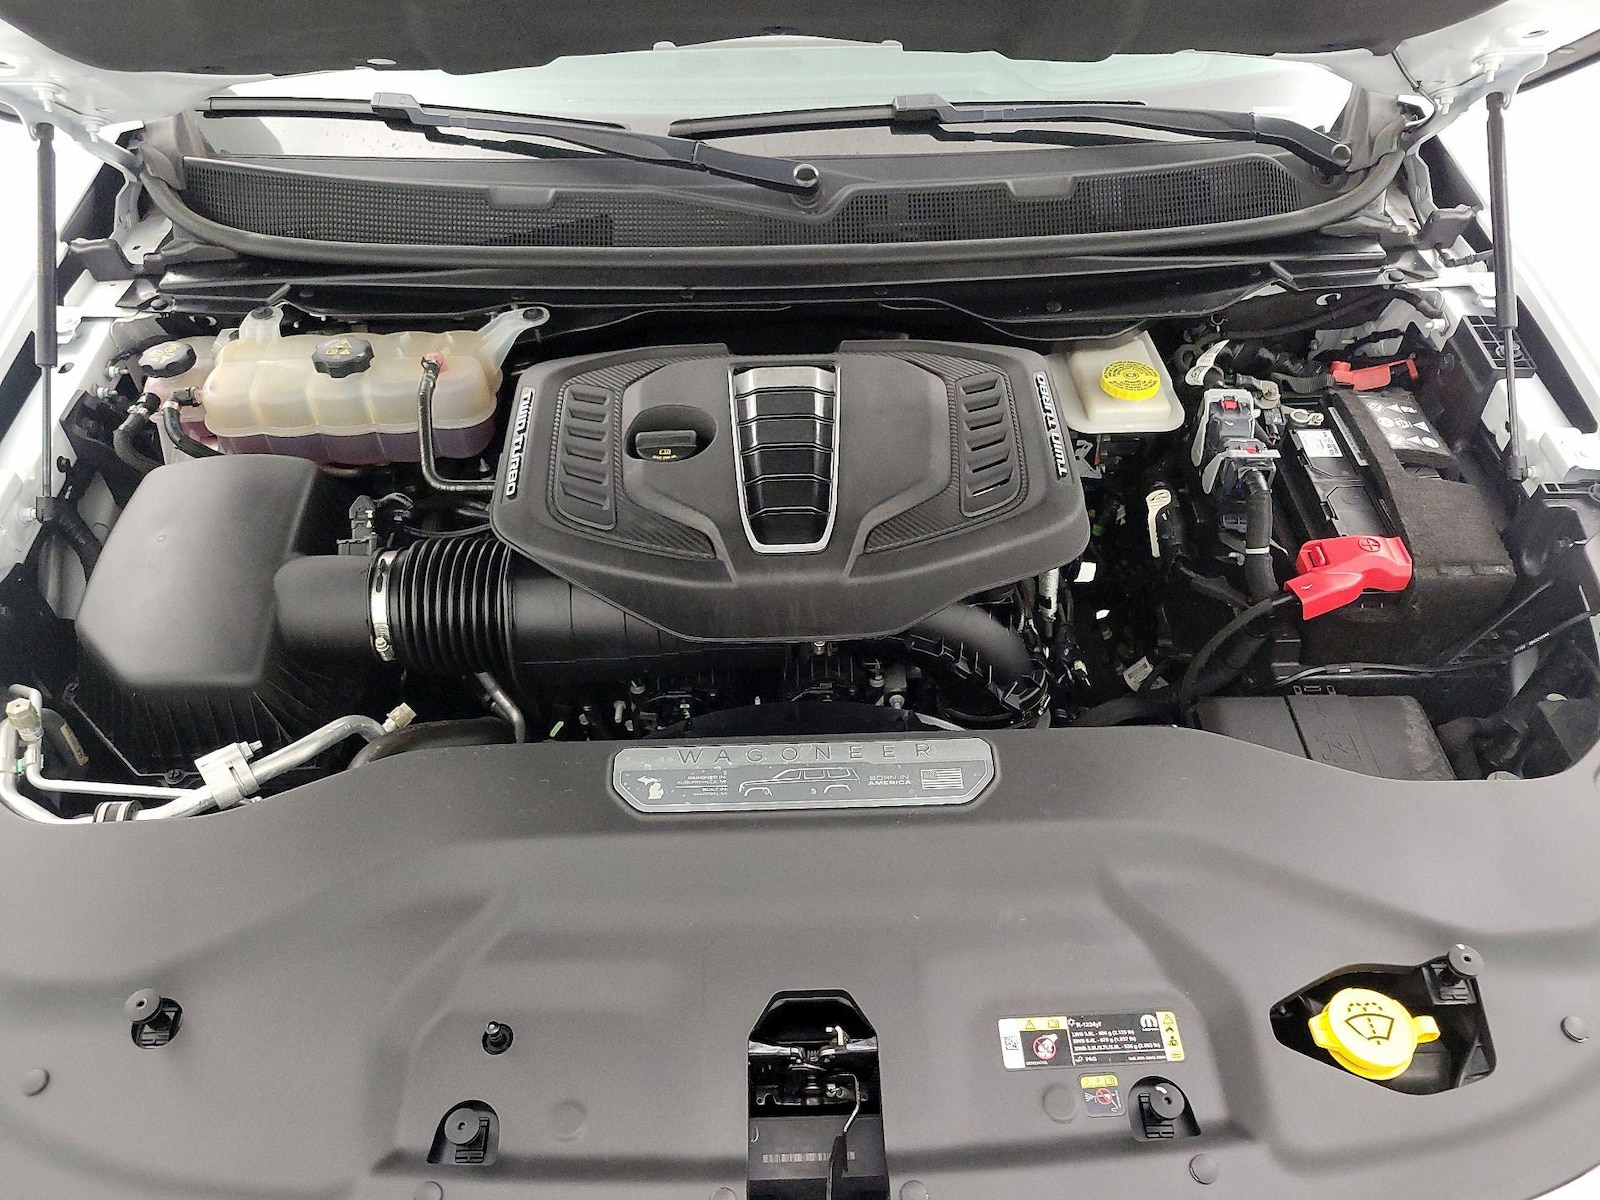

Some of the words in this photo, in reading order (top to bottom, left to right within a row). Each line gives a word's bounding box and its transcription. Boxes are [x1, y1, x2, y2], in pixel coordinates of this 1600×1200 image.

[516, 390, 534, 434] TWIN
[1036, 374, 1057, 431] TURBO
[505, 435, 526, 499] TURBO
[1050, 432, 1068, 480] TWIN
[677, 743, 931, 765] WAGONEER
